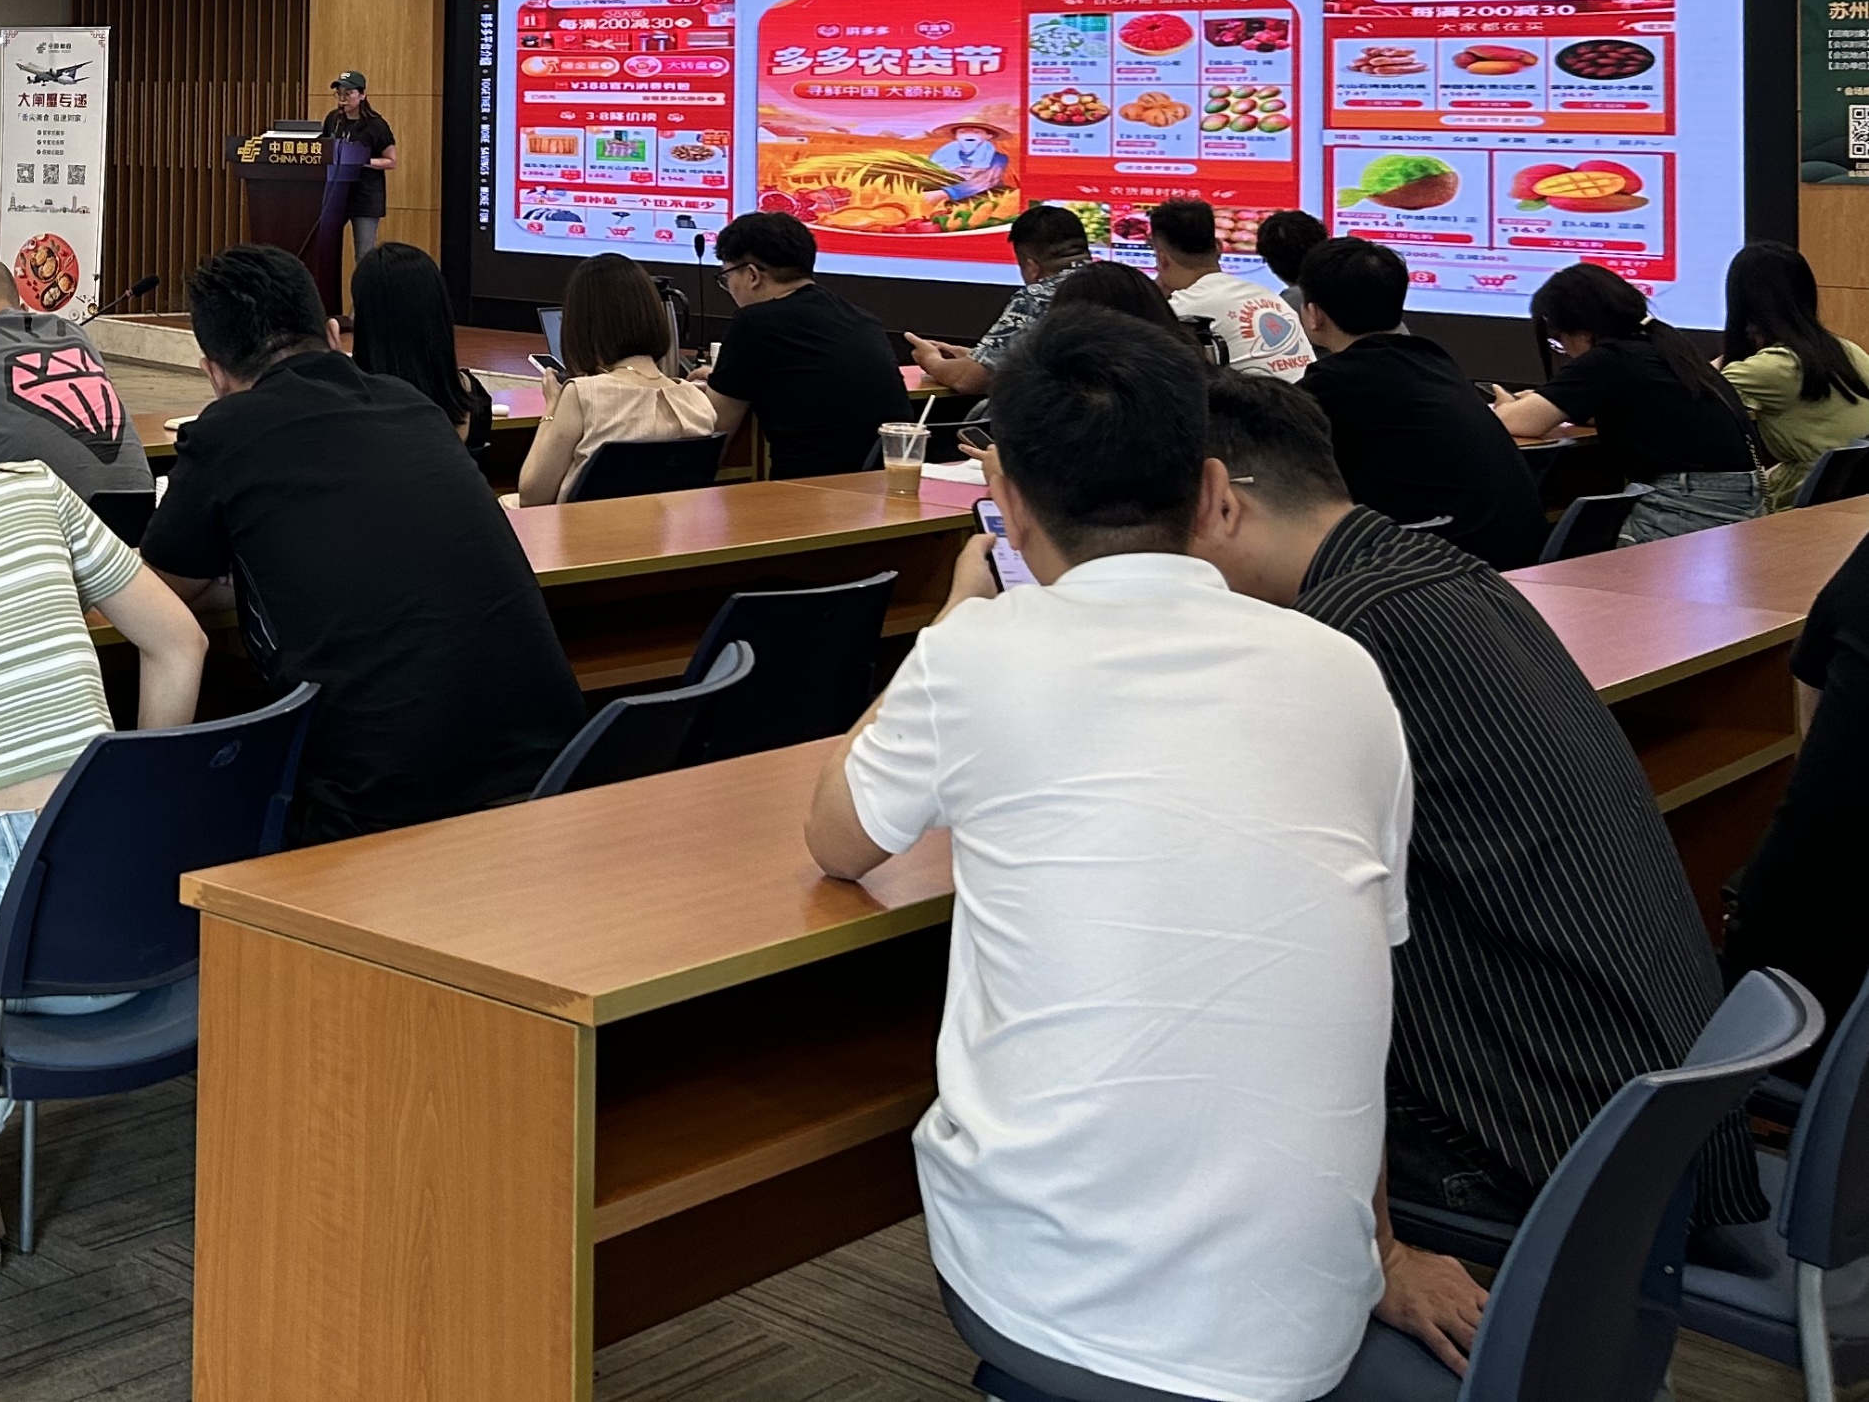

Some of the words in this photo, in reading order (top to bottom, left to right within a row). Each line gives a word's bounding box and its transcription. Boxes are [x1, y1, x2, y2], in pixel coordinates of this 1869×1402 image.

[1410, 5, 1576, 18] 每满200减30
[1829, 2, 1869, 19] 苏州
[558, 18, 674, 30] 每满200减30
[772, 45, 1004, 76] 多多农货节
[480, 78, 491, 113] TOGETHER
[885, 85, 962, 97] 大额补贴
[269, 141, 322, 154] 中国邮政
[269, 155, 297, 163] CHINA
[300, 155, 322, 164] POST
